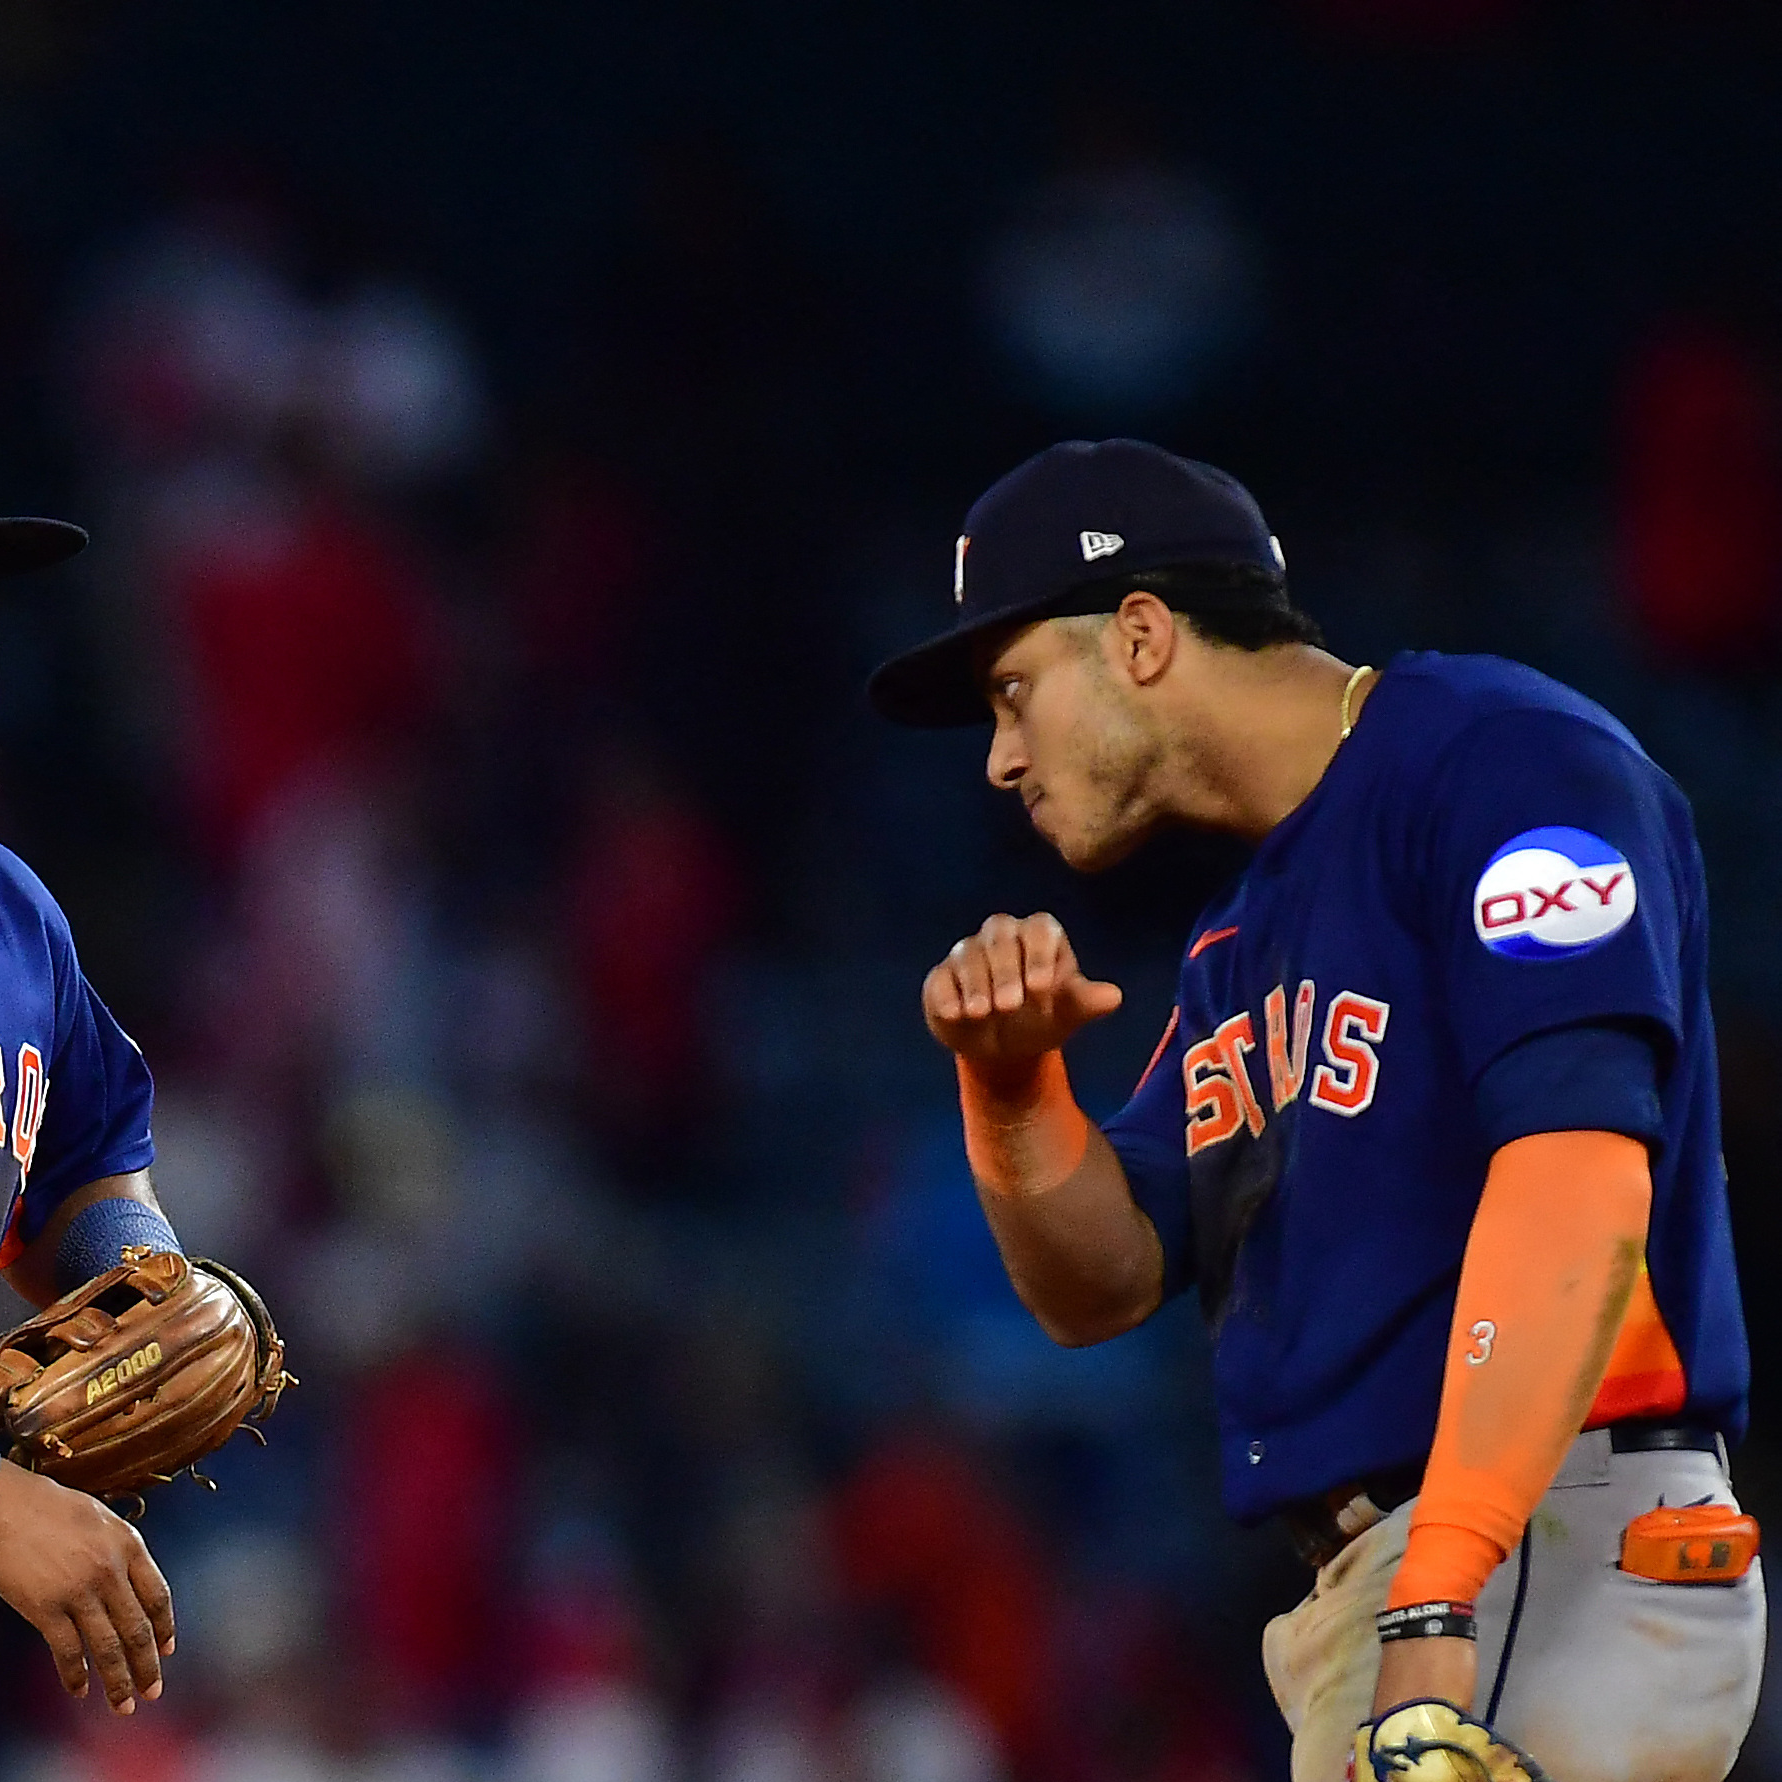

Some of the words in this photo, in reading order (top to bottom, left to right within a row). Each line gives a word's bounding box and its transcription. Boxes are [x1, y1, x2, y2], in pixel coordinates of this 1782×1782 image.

[1481, 872, 1625, 929] OXY
[1467, 1320, 1496, 1366] 3
[87, 1342, 162, 1405] A2000
